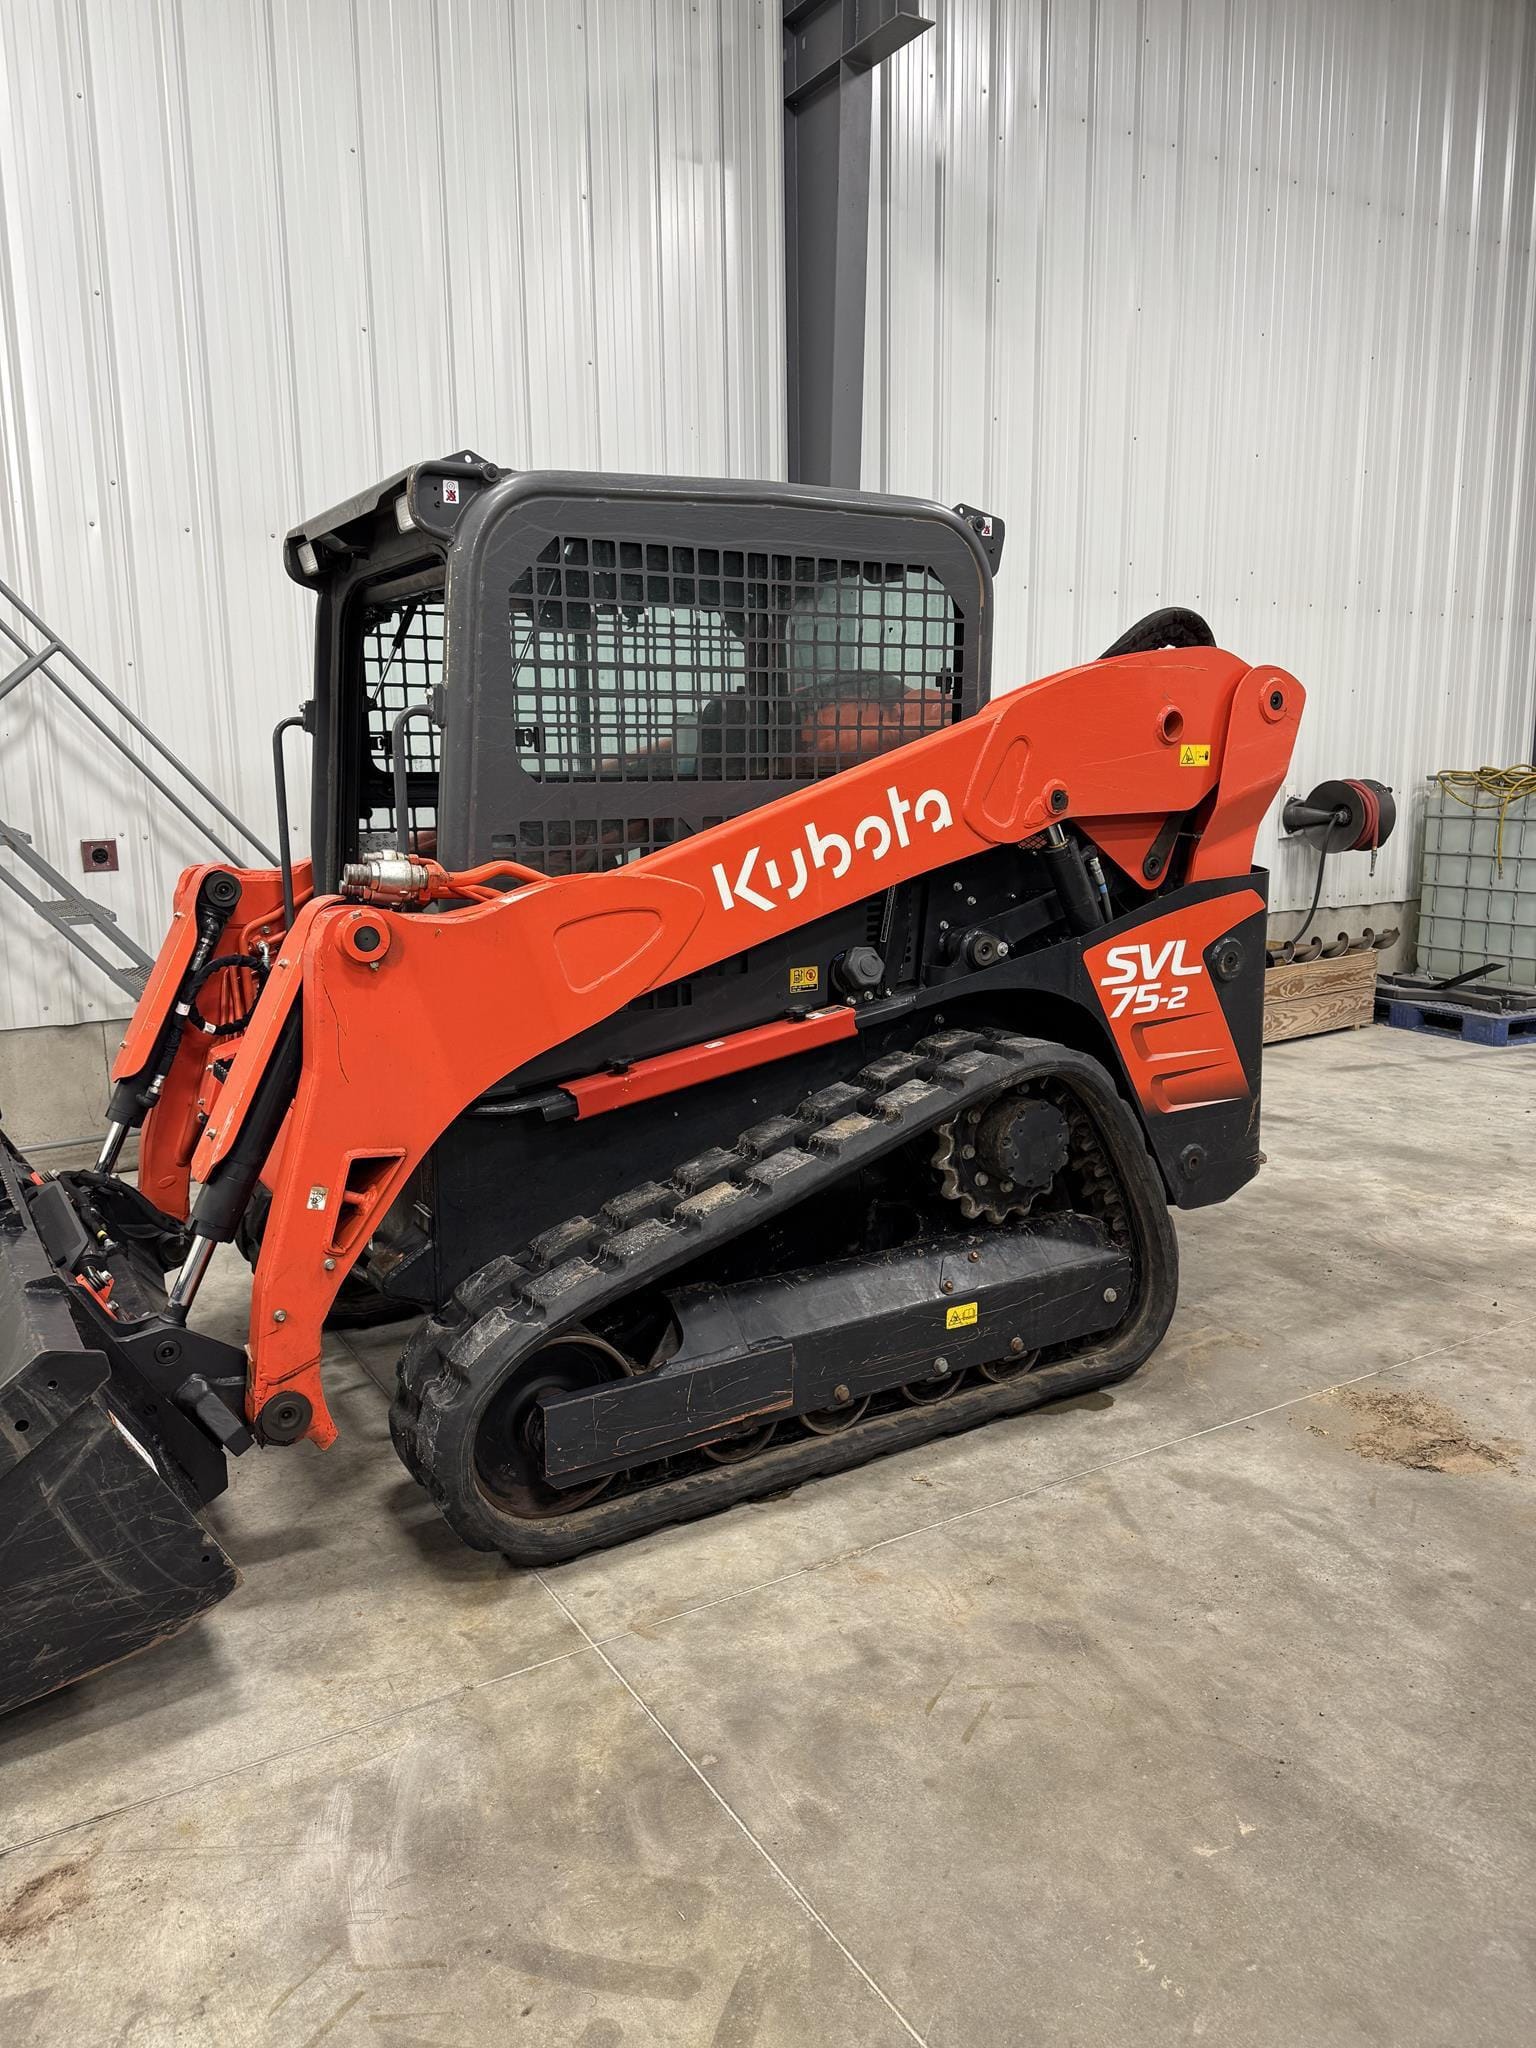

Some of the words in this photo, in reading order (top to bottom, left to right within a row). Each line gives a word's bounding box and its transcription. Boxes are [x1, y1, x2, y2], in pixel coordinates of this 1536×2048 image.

[712, 786, 953, 912] Kubota
[1100, 939, 1203, 987] SVL
[1110, 982, 1189, 1019] 75-2
